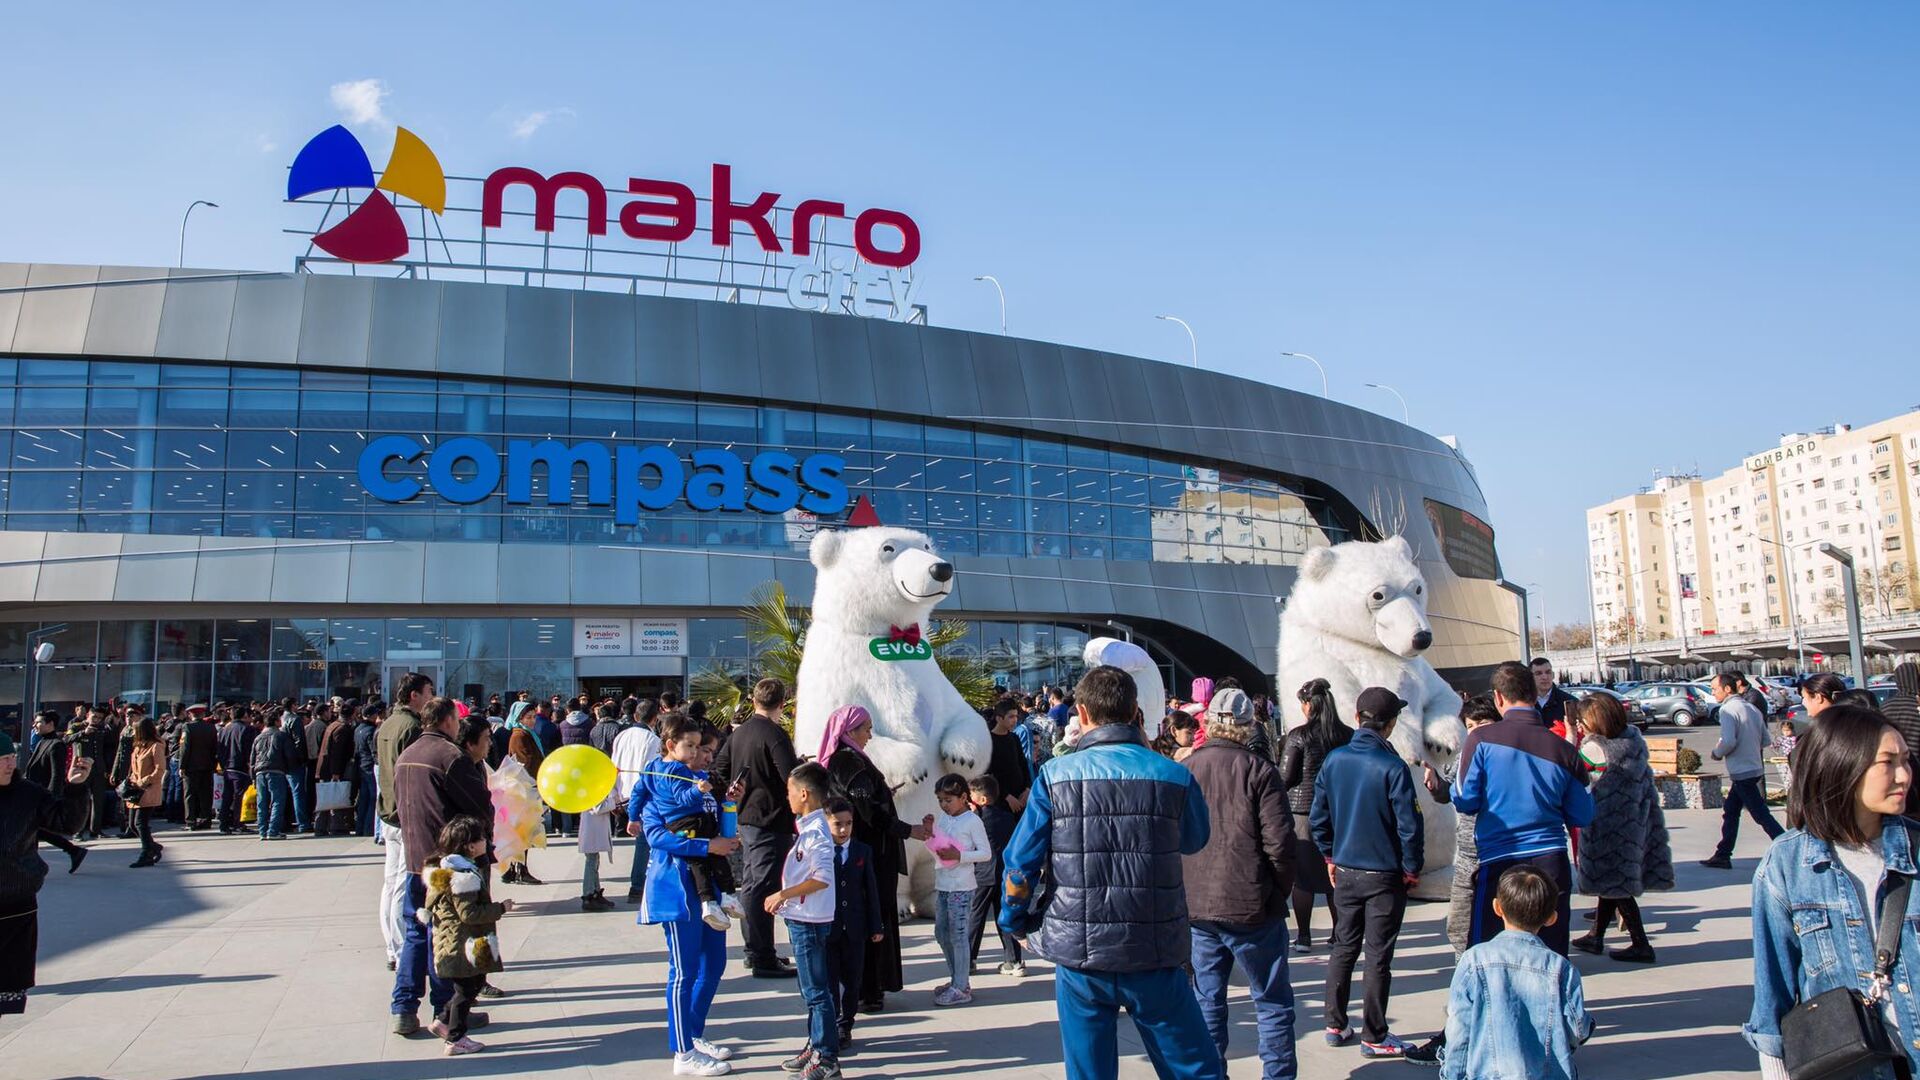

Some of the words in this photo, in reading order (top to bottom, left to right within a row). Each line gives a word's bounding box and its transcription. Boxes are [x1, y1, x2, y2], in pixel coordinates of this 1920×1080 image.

[482, 162, 922, 269] makro
[786, 256, 926, 322] city
[356, 434, 850, 526] compass
[1745, 440, 1816, 472] LOMBARD
[876, 642, 926, 656] EVOS
